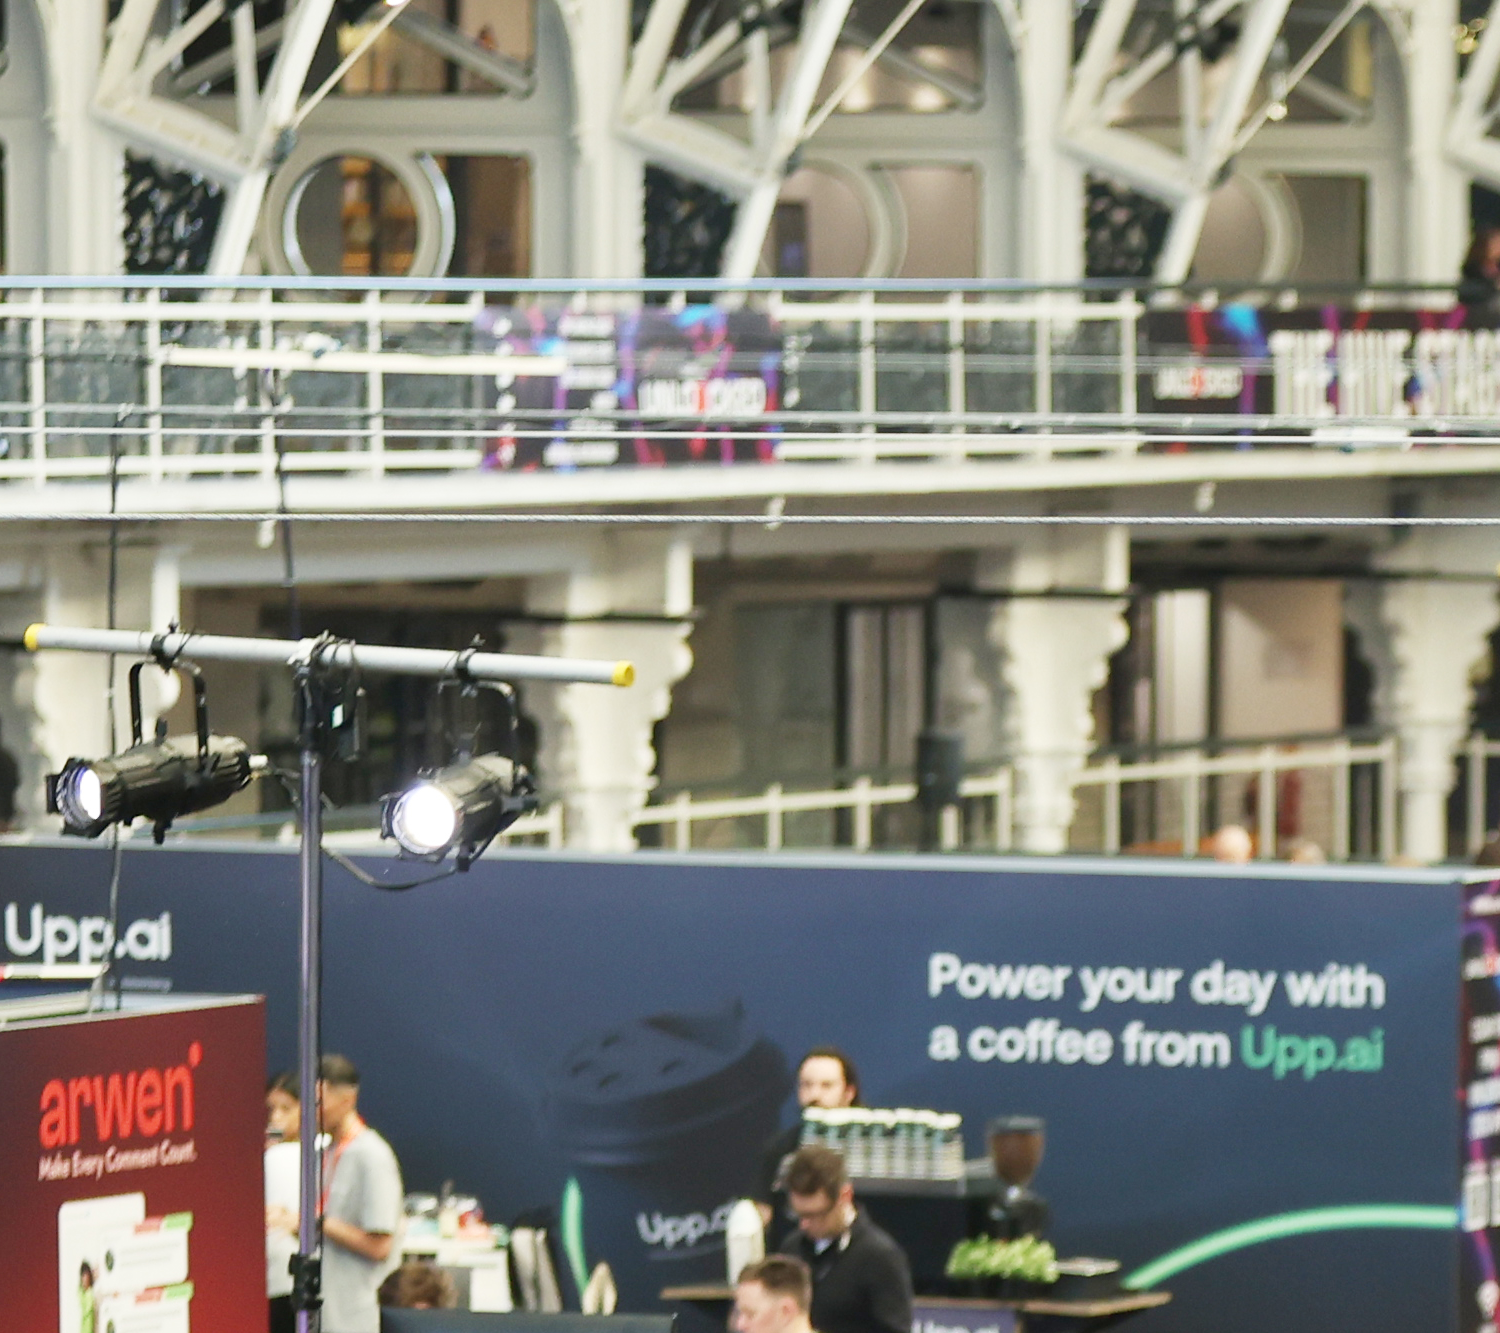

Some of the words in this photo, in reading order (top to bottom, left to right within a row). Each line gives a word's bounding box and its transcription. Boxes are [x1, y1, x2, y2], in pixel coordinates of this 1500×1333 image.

[4, 901, 173, 966] Upp.ai
[927, 951, 1074, 1000] Power
[1079, 965, 1184, 1012] your
[1190, 959, 1277, 1015] day
[1284, 961, 1387, 1008] with
[927, 1023, 961, 1061] a
[966, 1016, 1114, 1064] coffee
[1121, 1020, 1232, 1068] from
[1239, 1022, 1386, 1080] Upp.ai
[38, 1062, 196, 1150] arwen
[37, 1151, 71, 1182] Make
[71, 1150, 104, 1182] Every
[104, 1144, 160, 1174] Comment
[635, 1207, 729, 1249] Upp.a
